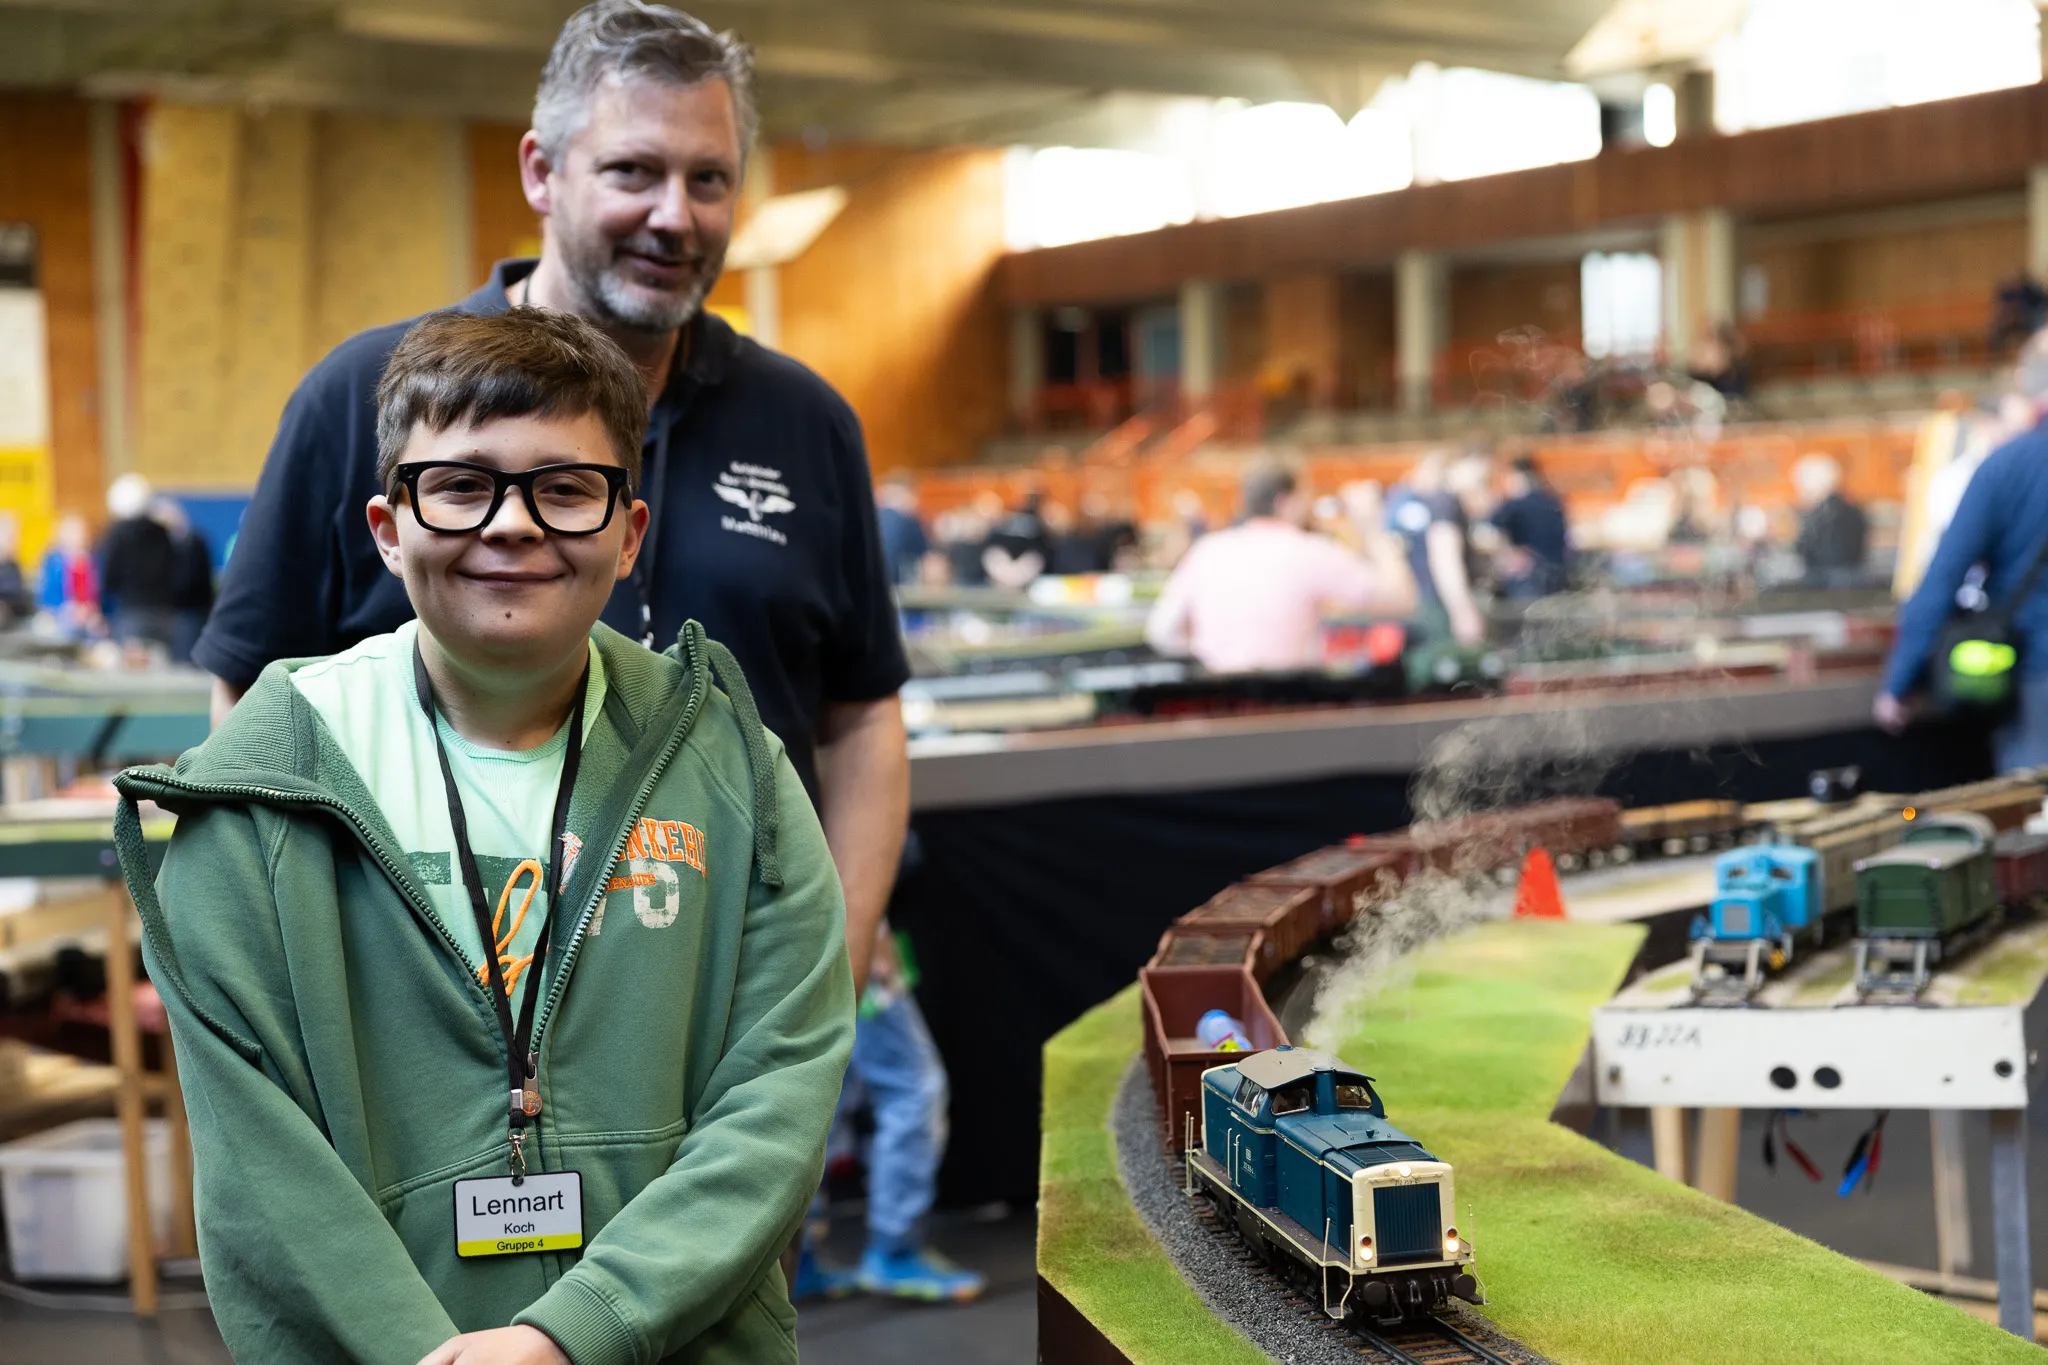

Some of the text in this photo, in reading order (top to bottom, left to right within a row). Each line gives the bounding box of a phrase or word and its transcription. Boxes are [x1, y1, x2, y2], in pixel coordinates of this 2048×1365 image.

[617, 816, 707, 878] NKER
[472, 1190, 564, 1216] Lennart
[504, 1222, 535, 1234] Koch
[496, 1239, 544, 1252] Gruppe 4
